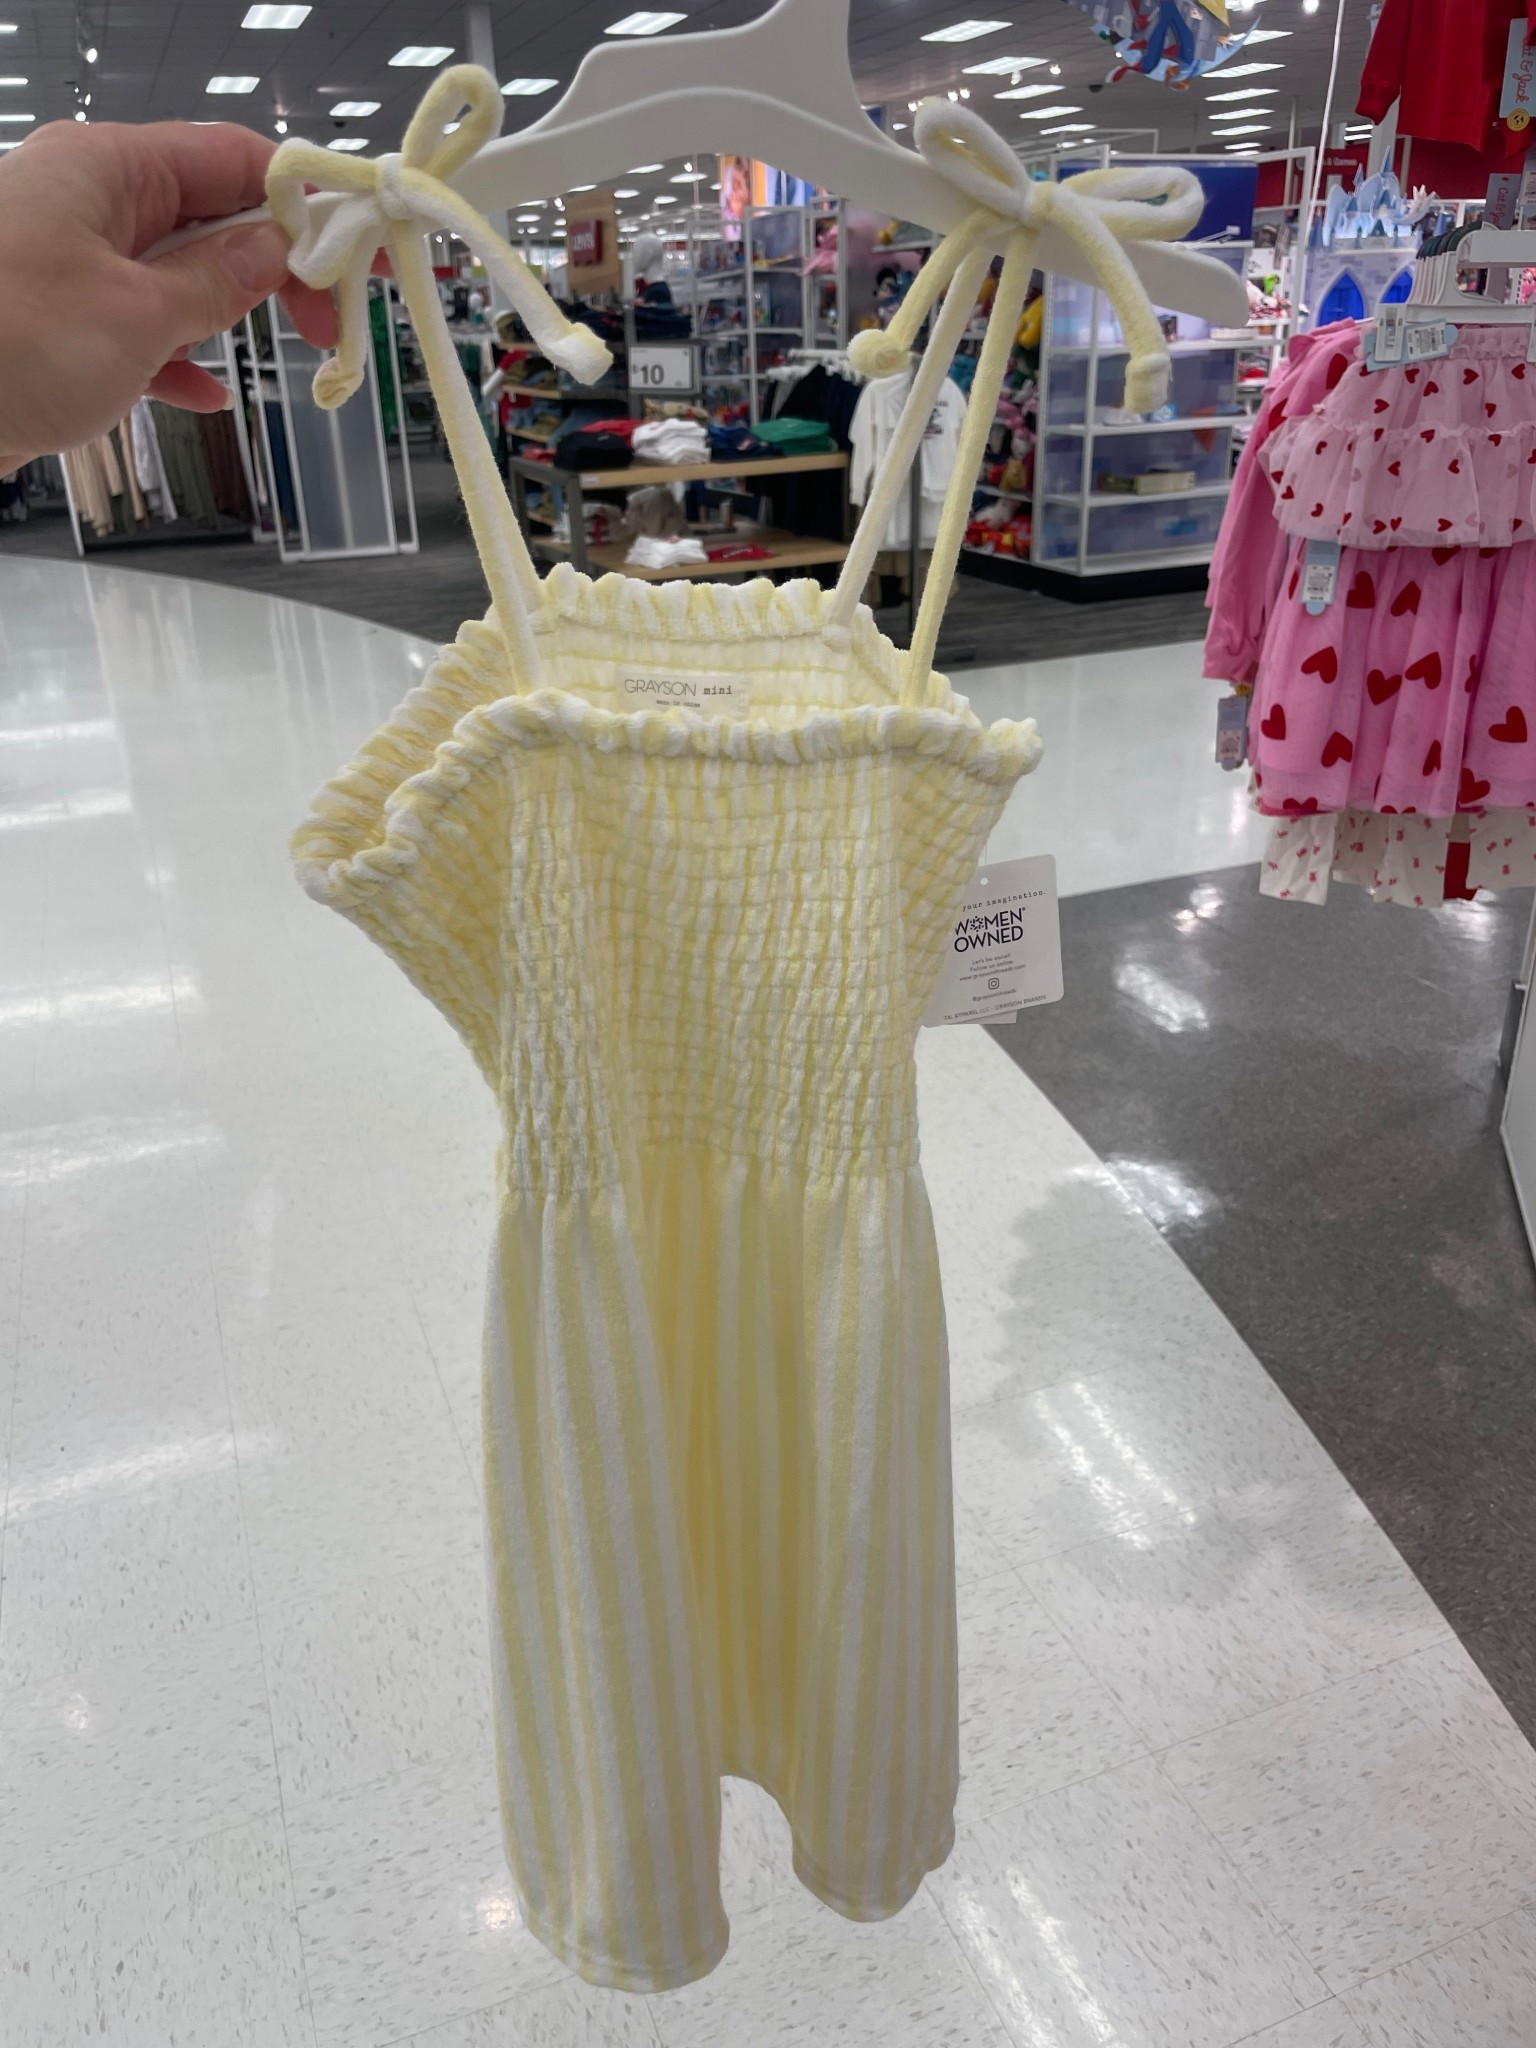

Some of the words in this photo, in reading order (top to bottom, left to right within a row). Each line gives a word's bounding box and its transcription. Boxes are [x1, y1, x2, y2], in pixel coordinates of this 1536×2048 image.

[1520, 61, 1533, 72] &
[1512, 73, 1532, 104] Jack
[624, 679, 697, 696] GRAYSON
[703, 685, 732, 695] mini
[962, 902, 983, 912] your
[954, 925, 1024, 952] OWNED
[995, 1000, 1022, 1010] GRAYSON
[1023, 994, 1047, 1004] BRANDS
